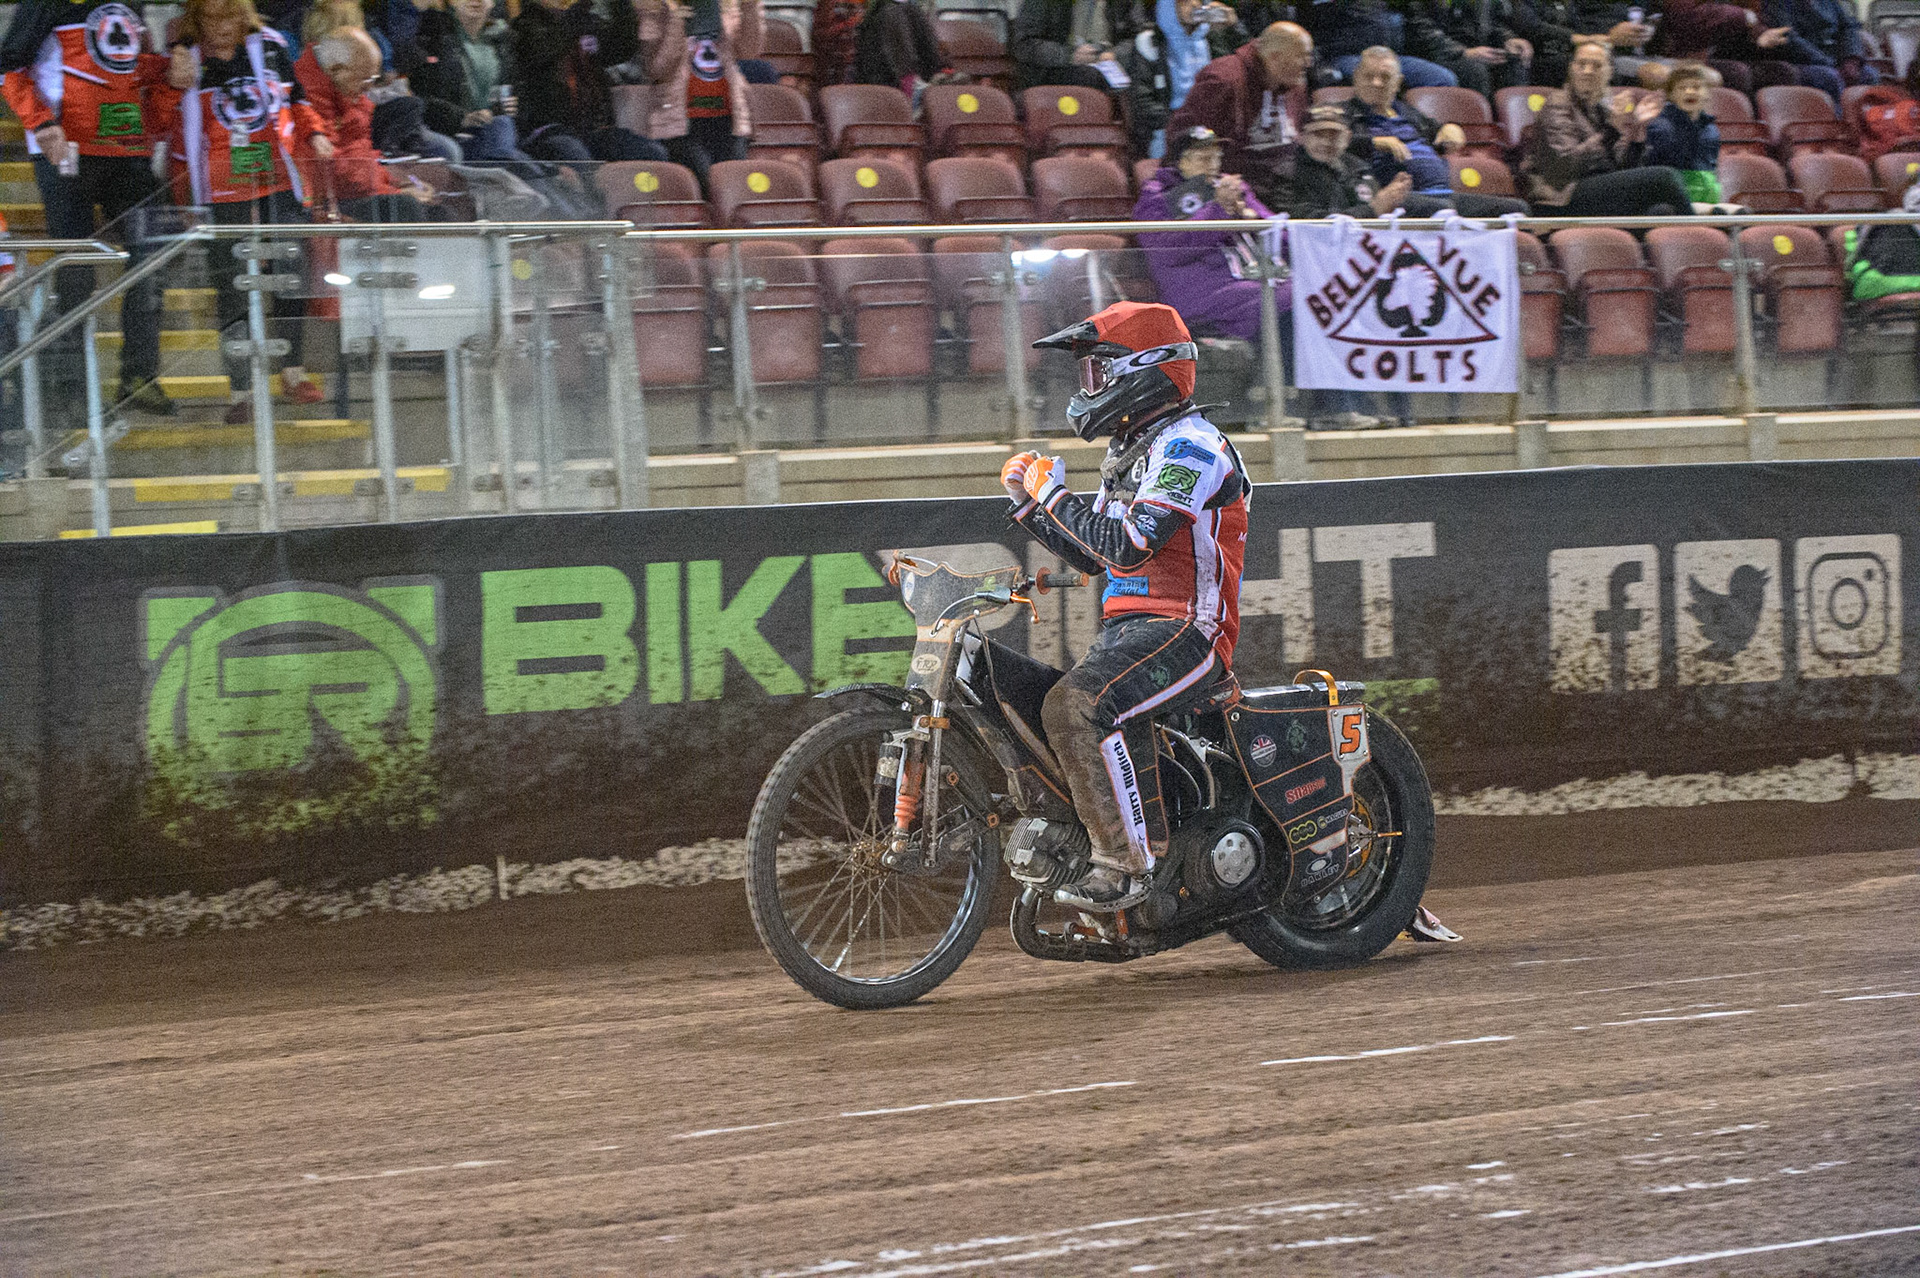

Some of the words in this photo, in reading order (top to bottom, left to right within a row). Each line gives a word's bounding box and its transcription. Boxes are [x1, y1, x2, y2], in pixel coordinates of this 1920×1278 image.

[1306, 232, 1385, 328] BELLE
[1438, 235, 1500, 316] VUE
[1347, 348, 1477, 383] COLTS
[1340, 713, 1362, 756] 5
[1113, 740, 1135, 790] Hilditch
[1128, 791, 1144, 827] Barry
[1301, 863, 1340, 887] OAKLEY
